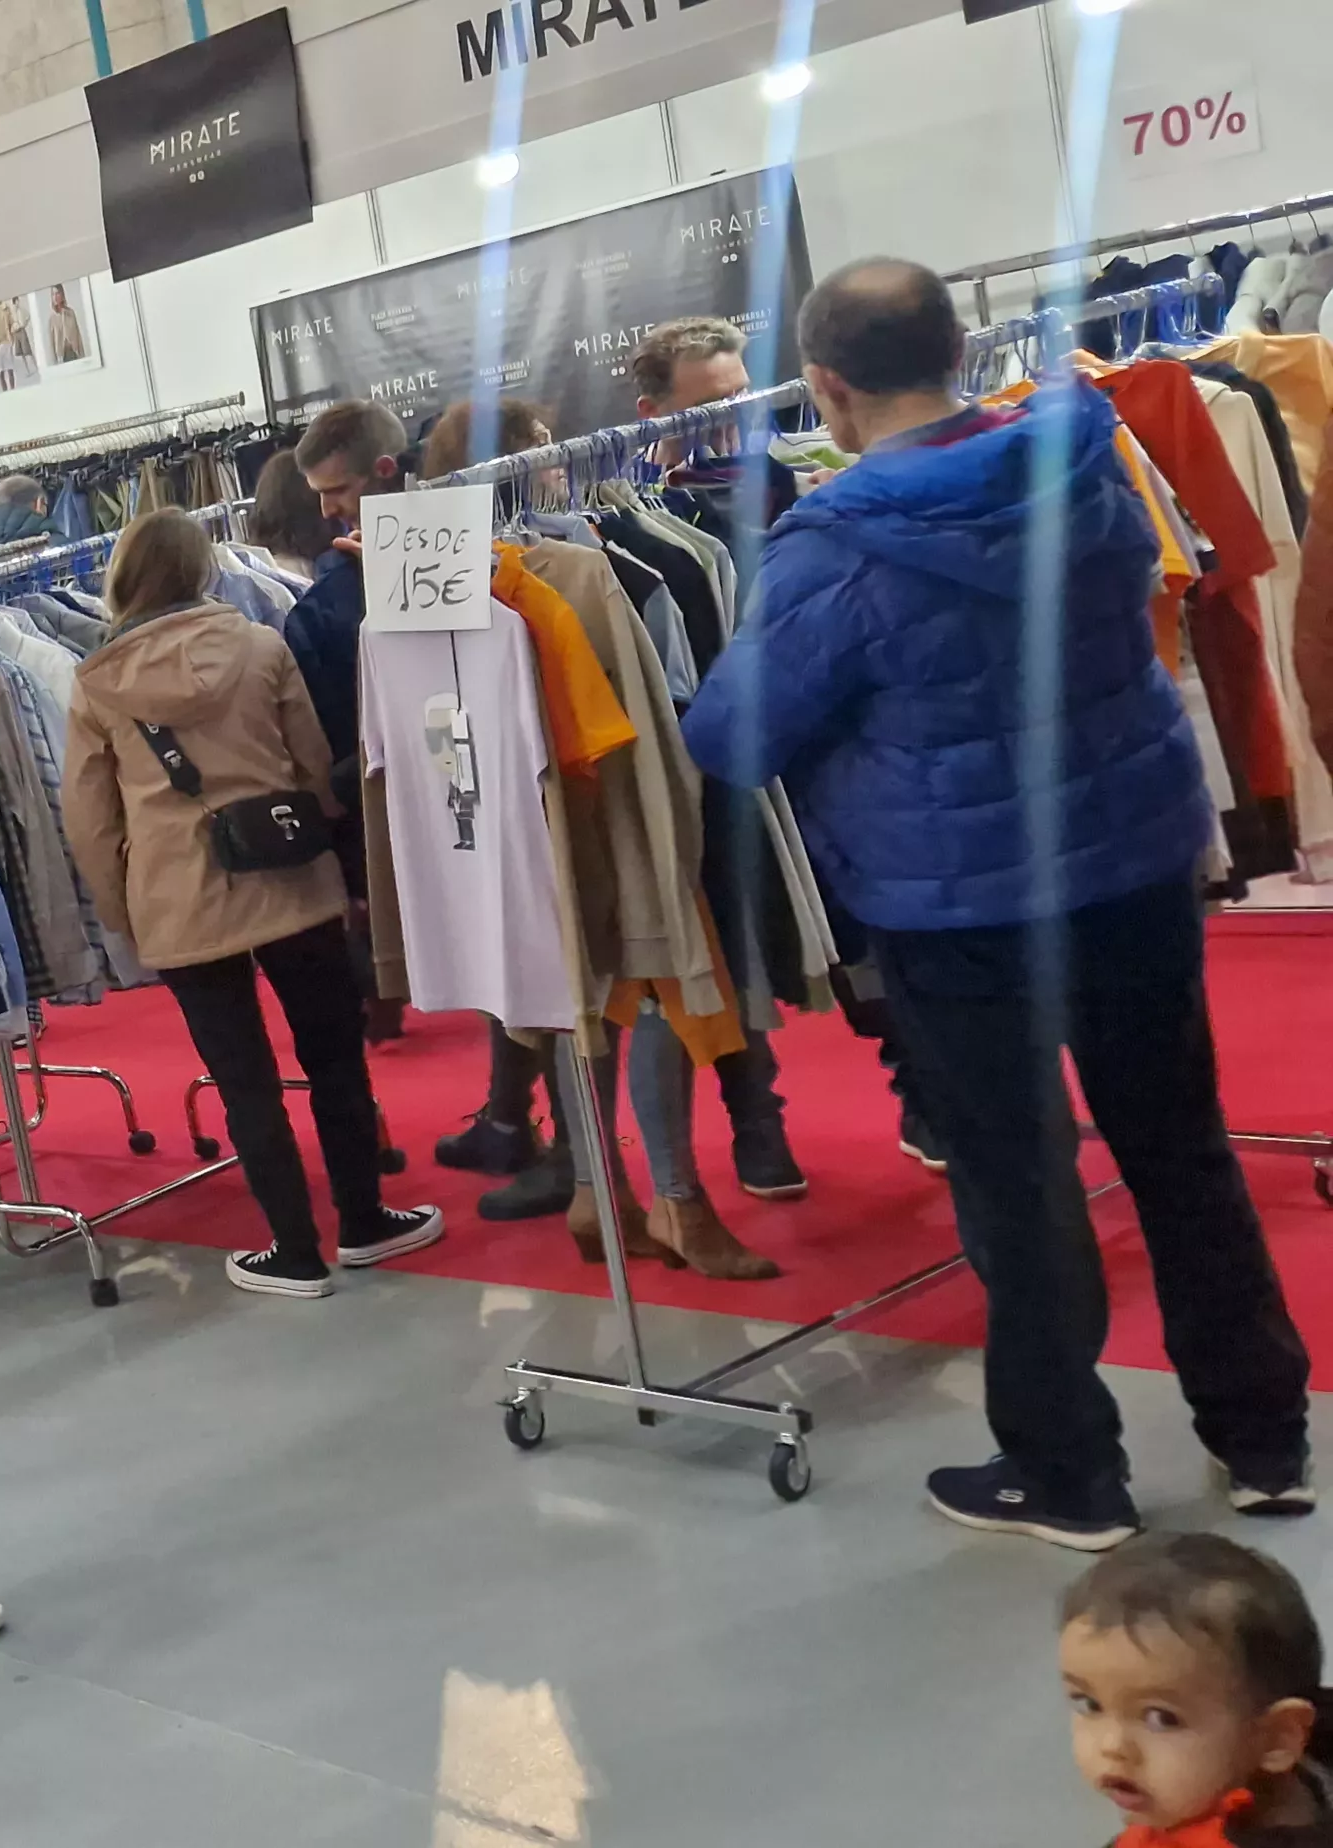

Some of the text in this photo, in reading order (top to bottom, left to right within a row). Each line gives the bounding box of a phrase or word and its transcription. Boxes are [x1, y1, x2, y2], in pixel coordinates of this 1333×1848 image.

[149, 110, 241, 165] MIRATE
[1123, 91, 1247, 156] 70%
[680, 206, 771, 244] MIRATE
[271, 316, 334, 347] MIRATE
[370, 370, 439, 401] MIRATE
[388, 560, 474, 612] 15€
